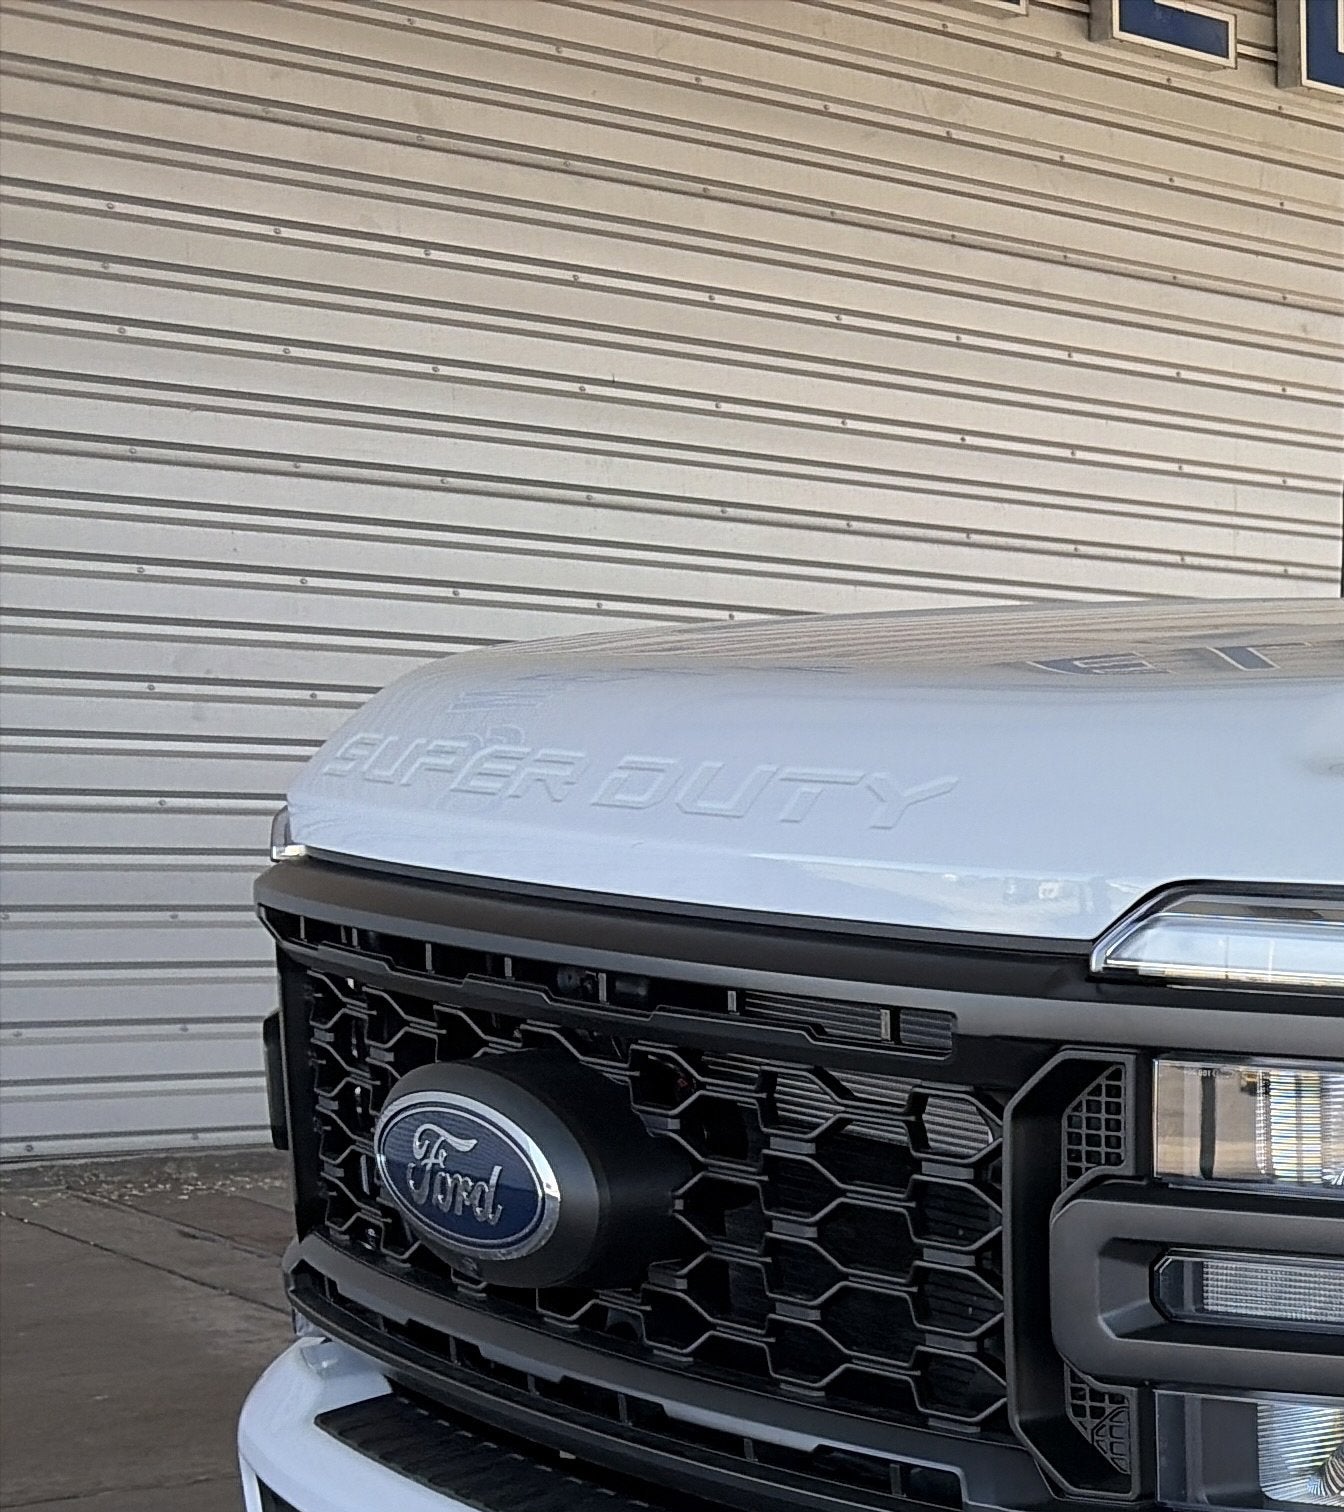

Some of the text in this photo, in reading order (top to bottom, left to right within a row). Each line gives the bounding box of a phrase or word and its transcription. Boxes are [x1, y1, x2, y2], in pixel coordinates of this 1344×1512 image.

[322, 733, 959, 830] SUPER DUTY
[406, 1124, 503, 1226] Ford
